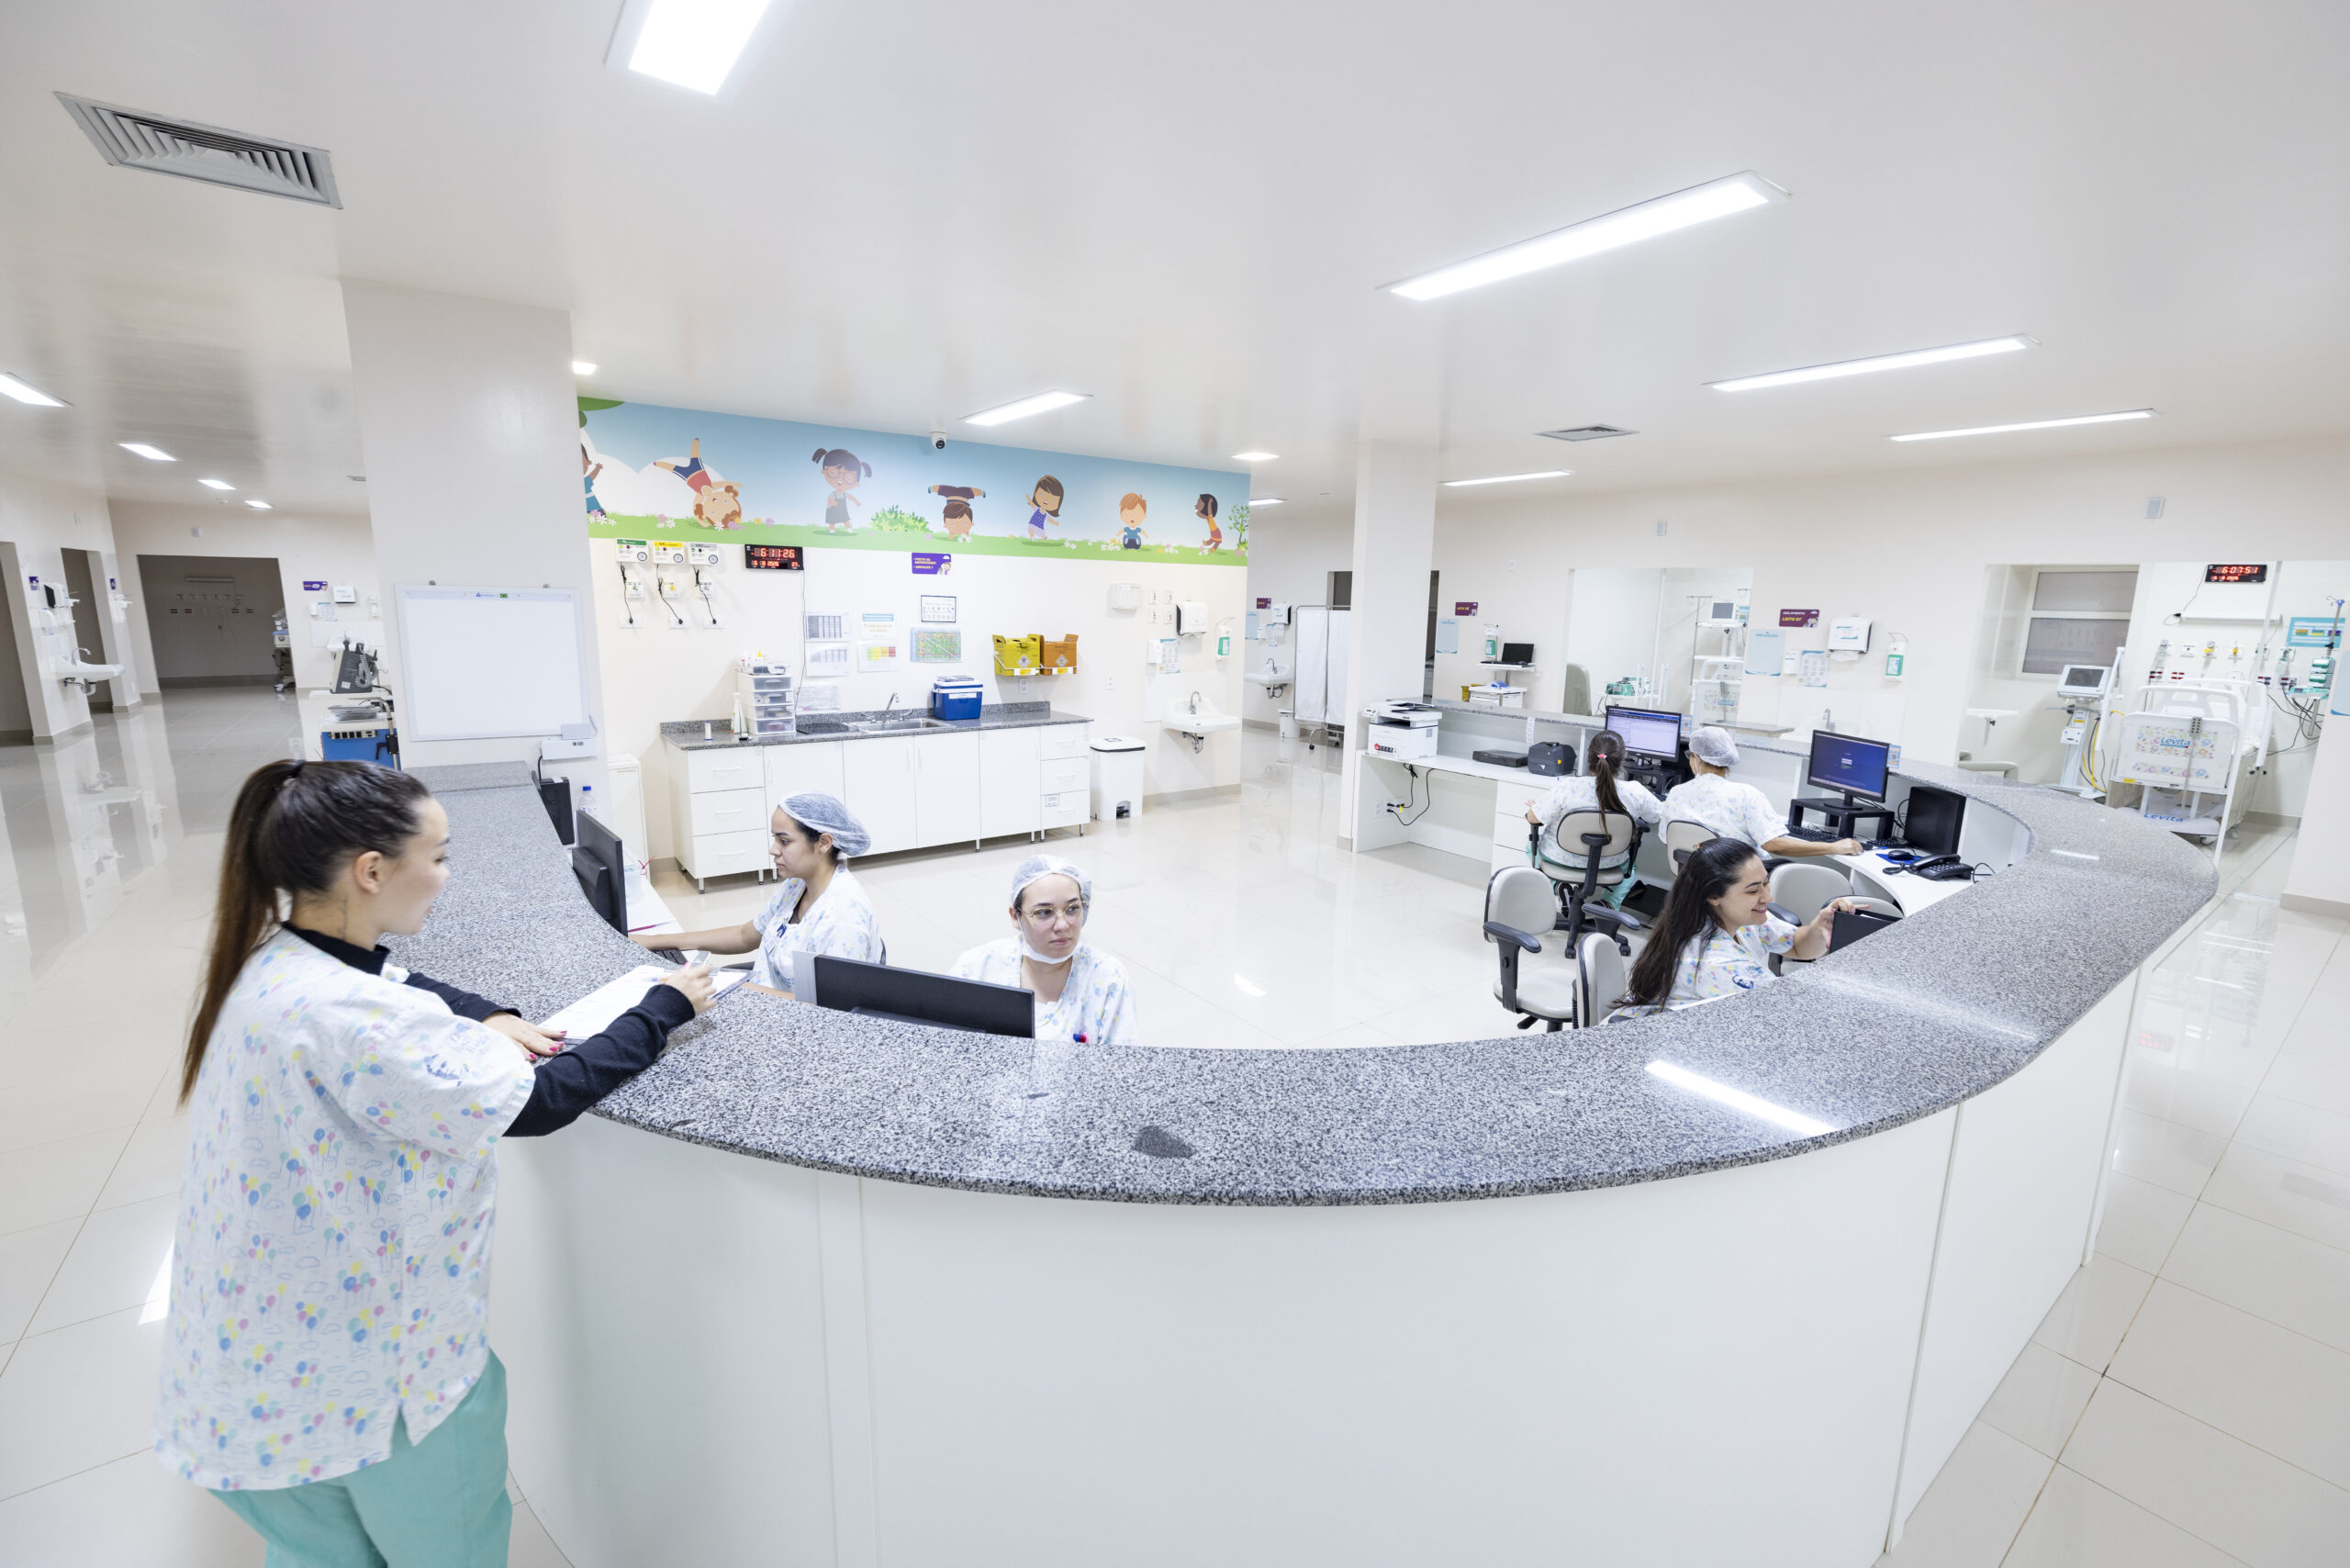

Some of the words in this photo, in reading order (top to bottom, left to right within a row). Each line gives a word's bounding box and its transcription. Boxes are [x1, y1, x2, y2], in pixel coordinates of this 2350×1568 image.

[760, 547, 795, 559] 6:11:26
[2221, 566, 2259, 575] 6:07:51
[2160, 737, 2191, 745] Levita
[2143, 812, 2185, 823] Levita
